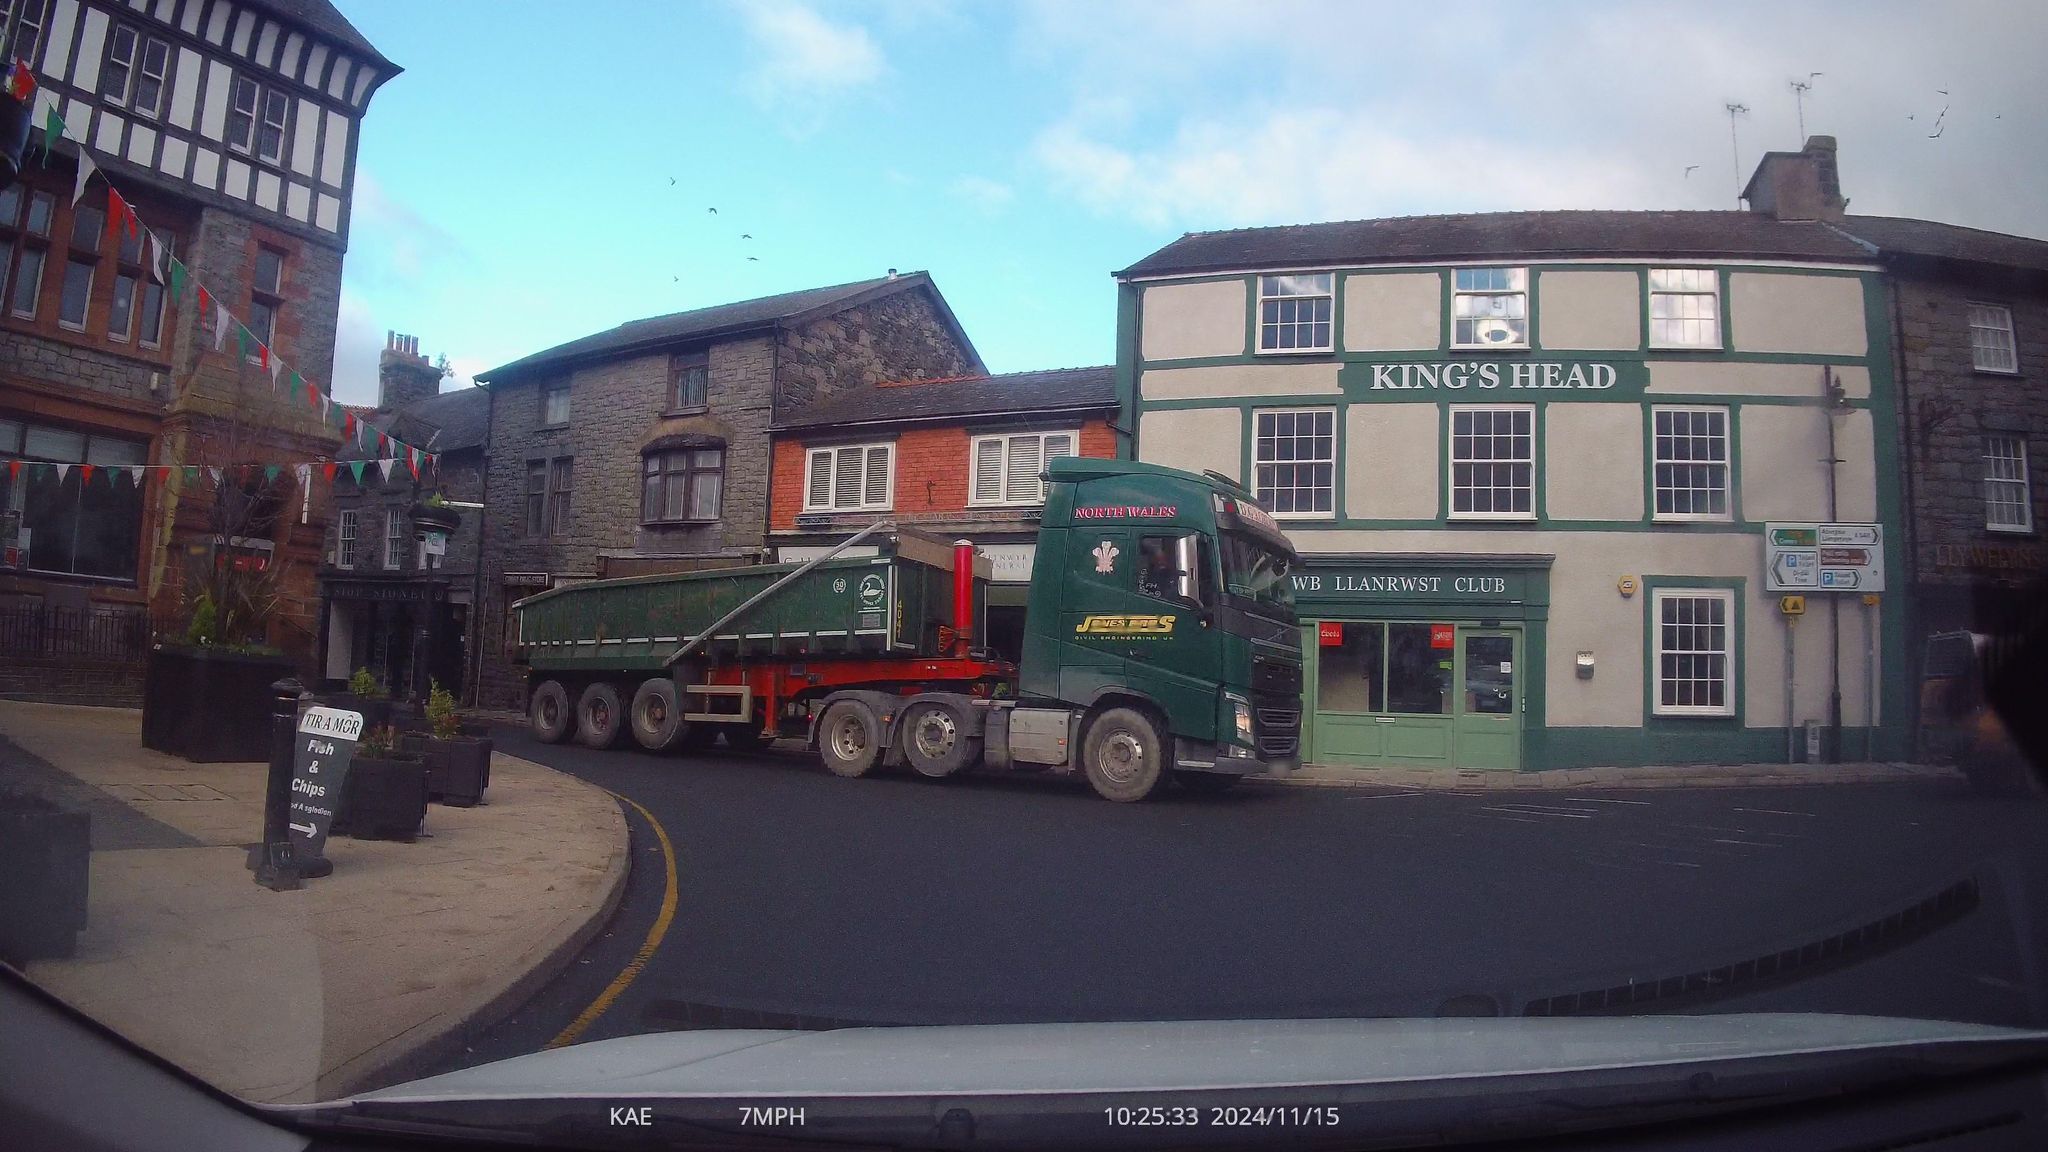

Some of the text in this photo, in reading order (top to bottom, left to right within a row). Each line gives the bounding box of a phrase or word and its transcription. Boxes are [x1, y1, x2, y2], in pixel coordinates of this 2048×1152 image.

[1370, 362, 1618, 390] KING'S HEAD
[1074, 506, 1177, 519] NORTH WALES
[1335, 576, 1441, 592] LLANRWST
[1454, 576, 1506, 593] CLUB
[305, 713, 323, 731] TIR
[322, 716, 331, 730] A
[307, 739, 335, 756] Fish
[308, 760, 319, 774] &
[291, 778, 326, 798] Chips
